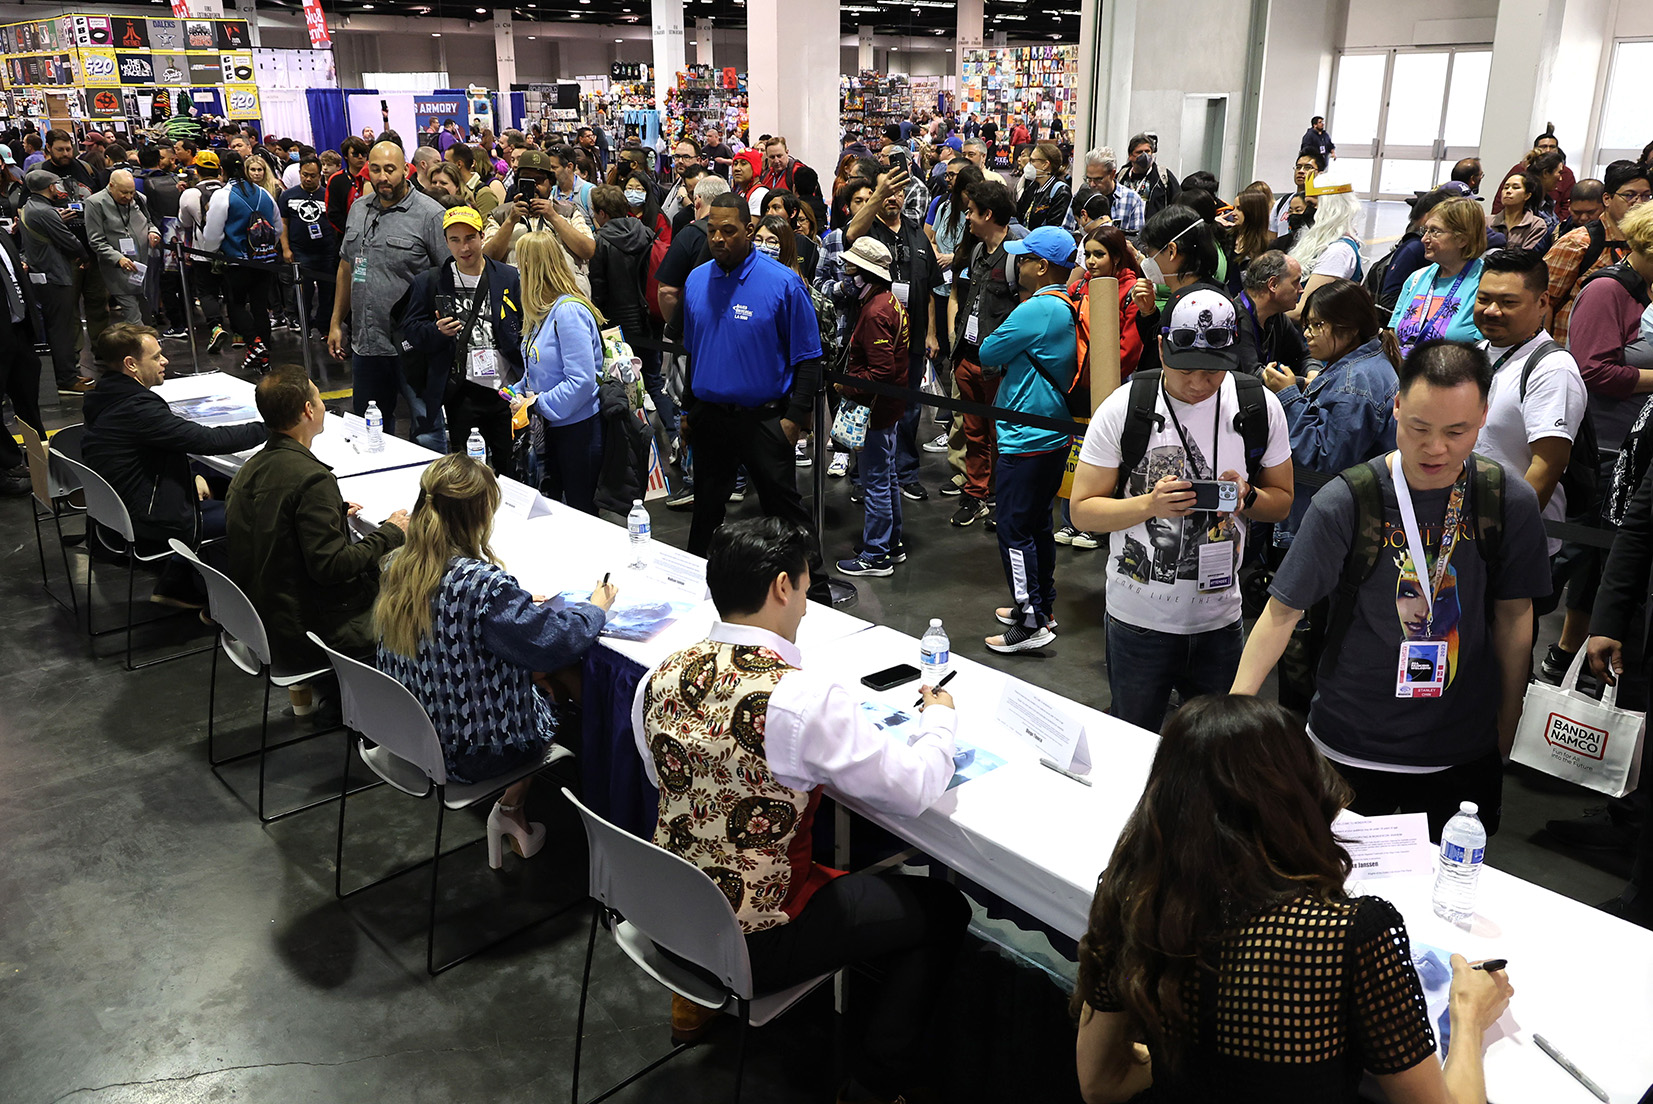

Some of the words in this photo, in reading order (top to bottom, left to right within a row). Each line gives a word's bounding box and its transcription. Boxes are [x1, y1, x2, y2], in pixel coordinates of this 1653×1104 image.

[85, 57, 114, 76] $20
[229, 92, 255, 109] $20
[419, 103, 457, 113] ARMORY
[1115, 577, 1141, 594] LONG
[1150, 592, 1179, 603] LIVE
[1553, 719, 1601, 744] BANDAI
[1551, 729, 1598, 753] NAMCO
[1552, 748, 1563, 756] Fun
[1562, 757, 1572, 765] the
[1572, 761, 1593, 771] Future
